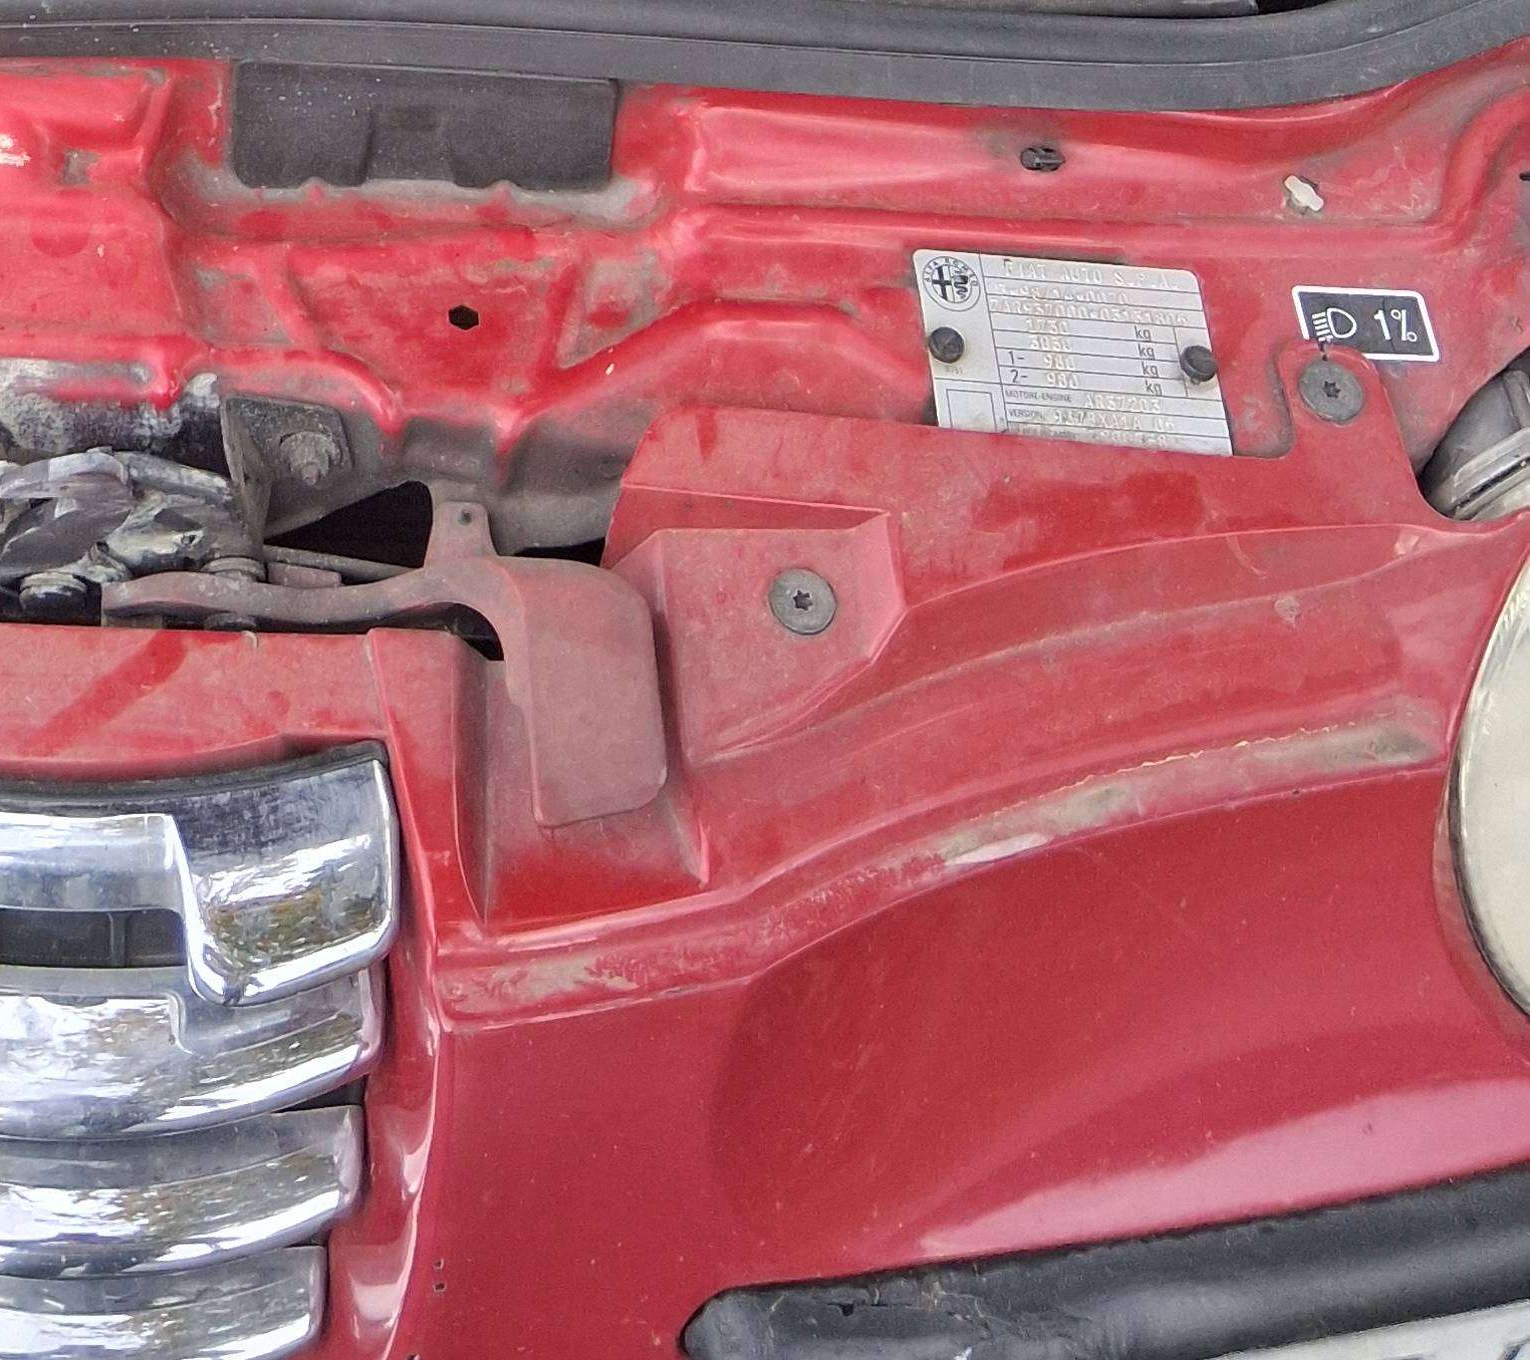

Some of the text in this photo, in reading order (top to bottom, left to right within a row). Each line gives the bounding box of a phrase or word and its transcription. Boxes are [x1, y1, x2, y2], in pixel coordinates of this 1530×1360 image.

[1002, 259, 1047, 281] FIAT
[1061, 265, 1103, 285] AUTO
[1134, 325, 1152, 341] kg
[1373, 308, 1418, 342] 1%
[1138, 343, 1156, 360] kg
[1142, 361, 1159, 378] kg
[1145, 379, 1162, 395] kg
